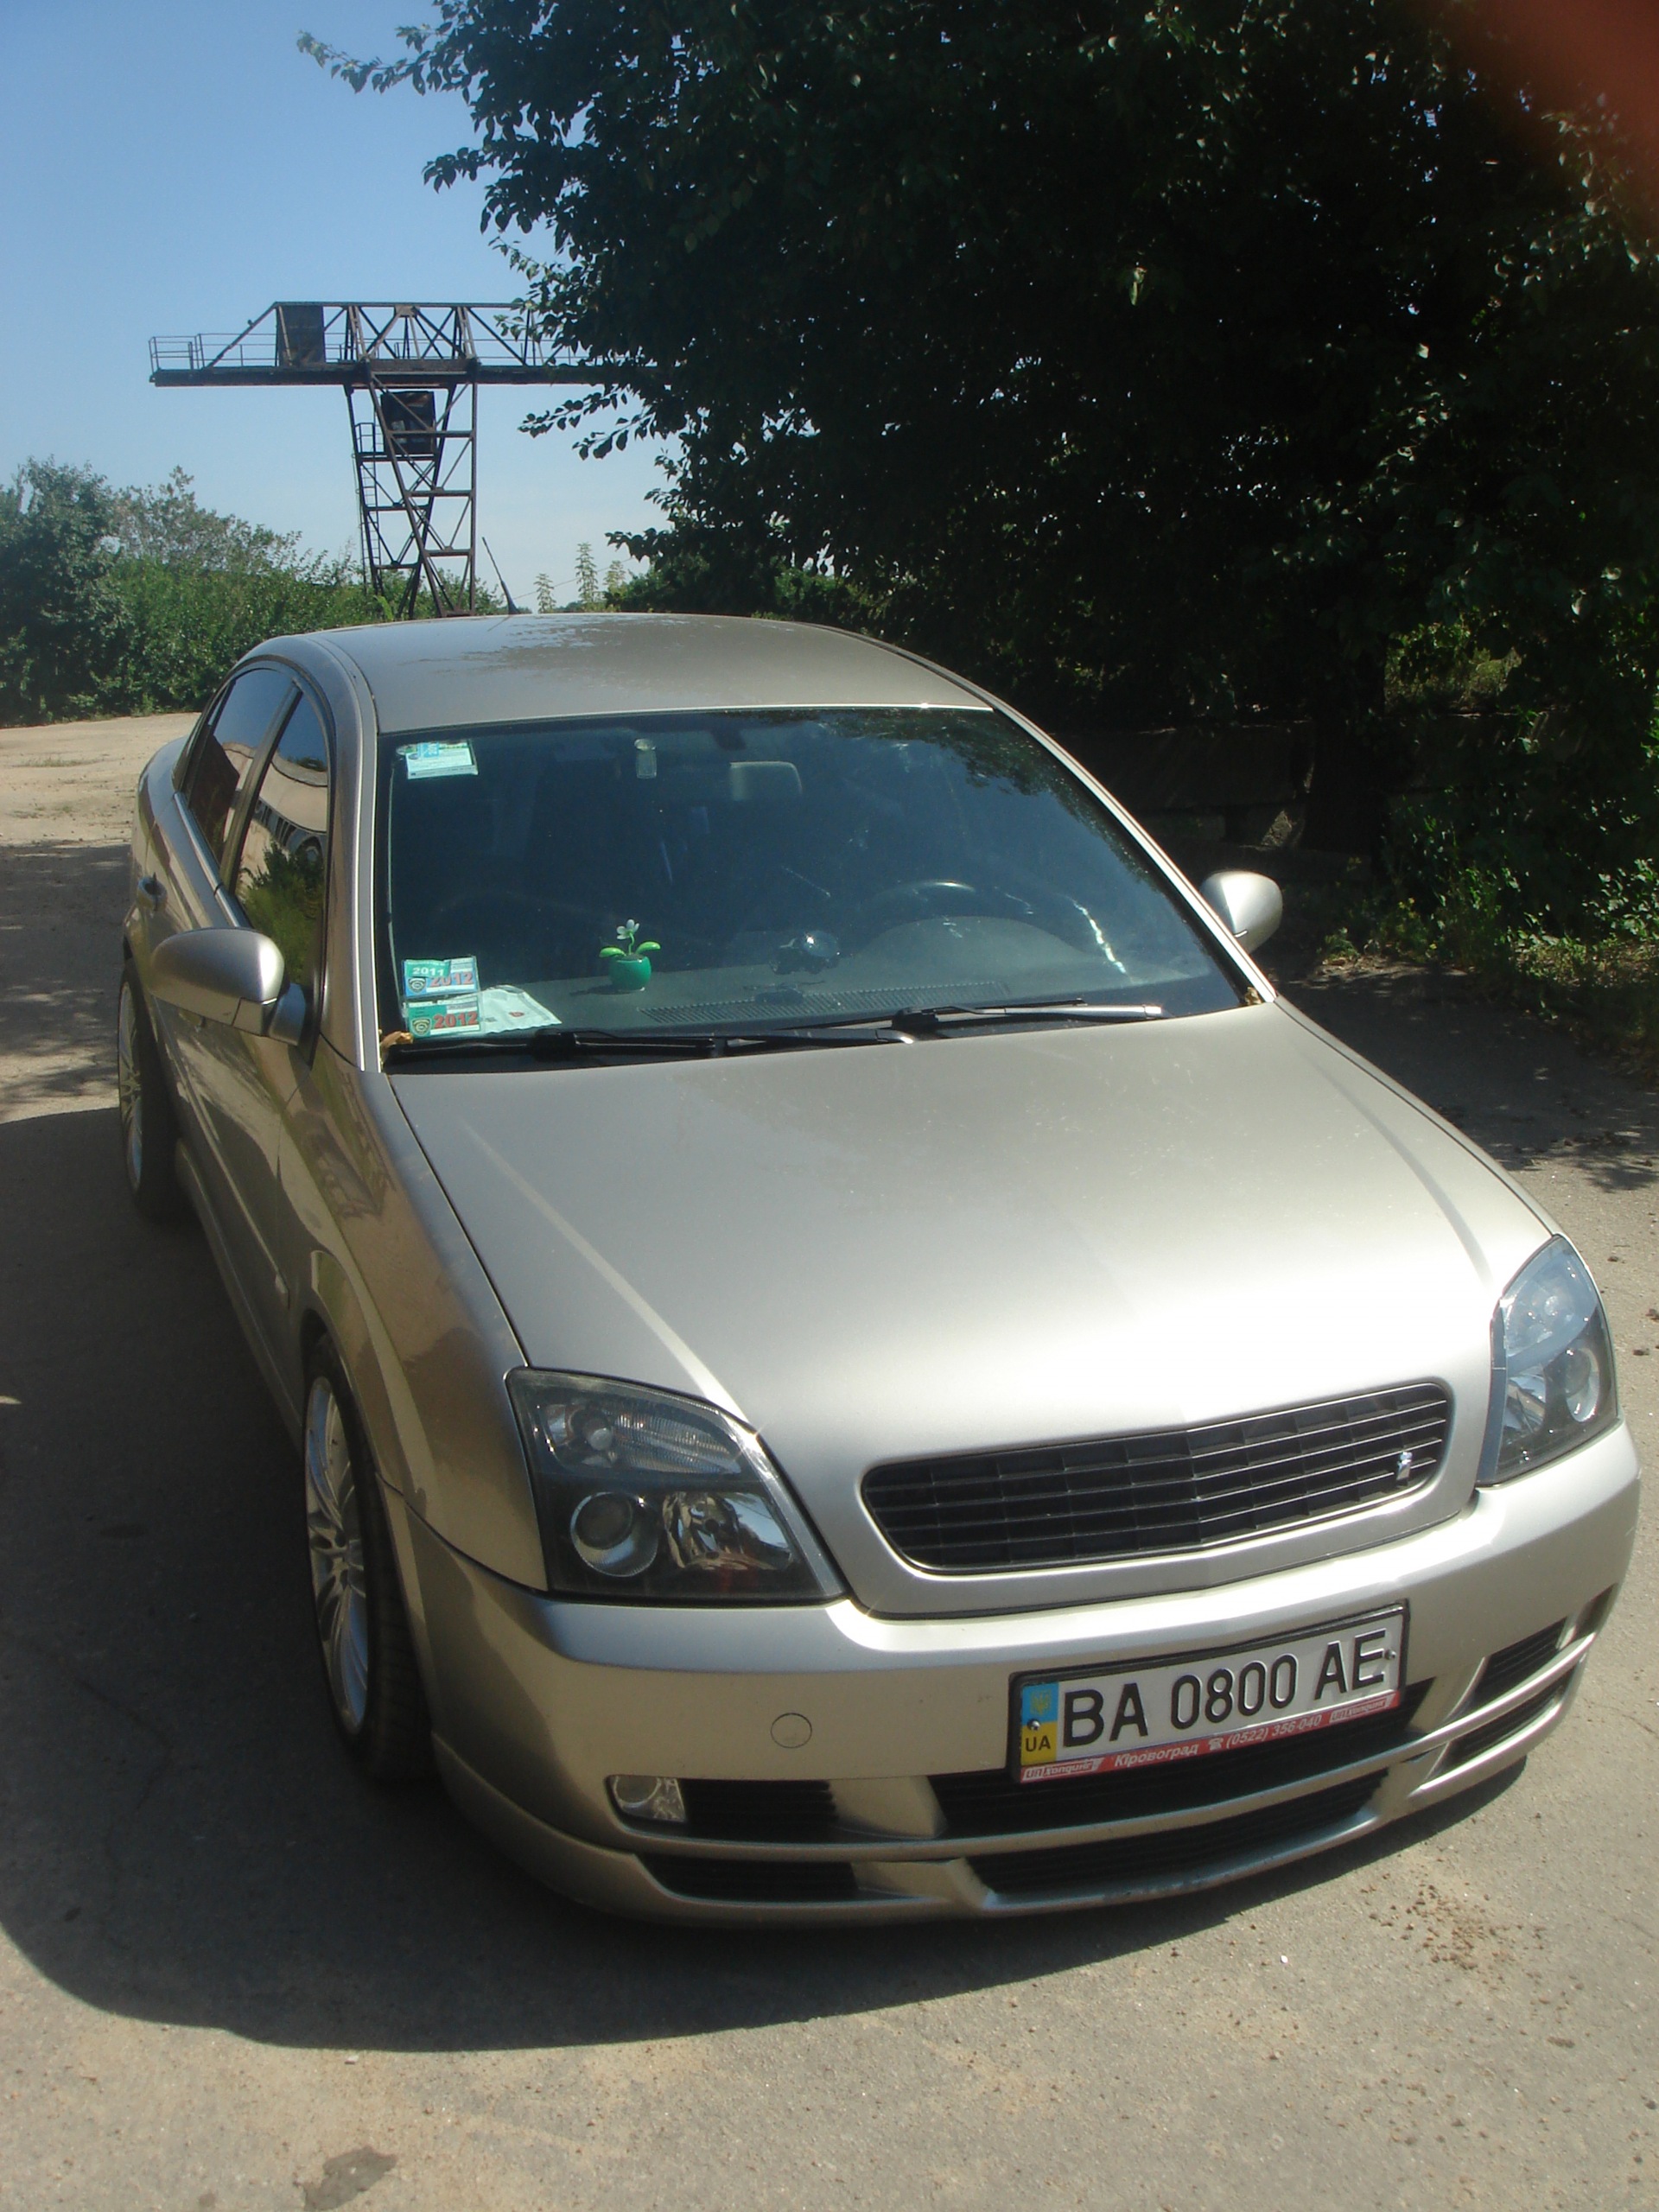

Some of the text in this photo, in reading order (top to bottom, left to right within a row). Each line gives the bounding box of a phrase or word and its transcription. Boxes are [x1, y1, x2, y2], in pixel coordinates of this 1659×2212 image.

[411, 967, 445, 976] 2011
[430, 972, 474, 987] 2012
[433, 1011, 478, 1029] 2012
[1062, 1629, 1388, 1747] BA 0800 AE
[1024, 1734, 1052, 1753] UA
[1226, 1728, 1268, 1749] (0522)
